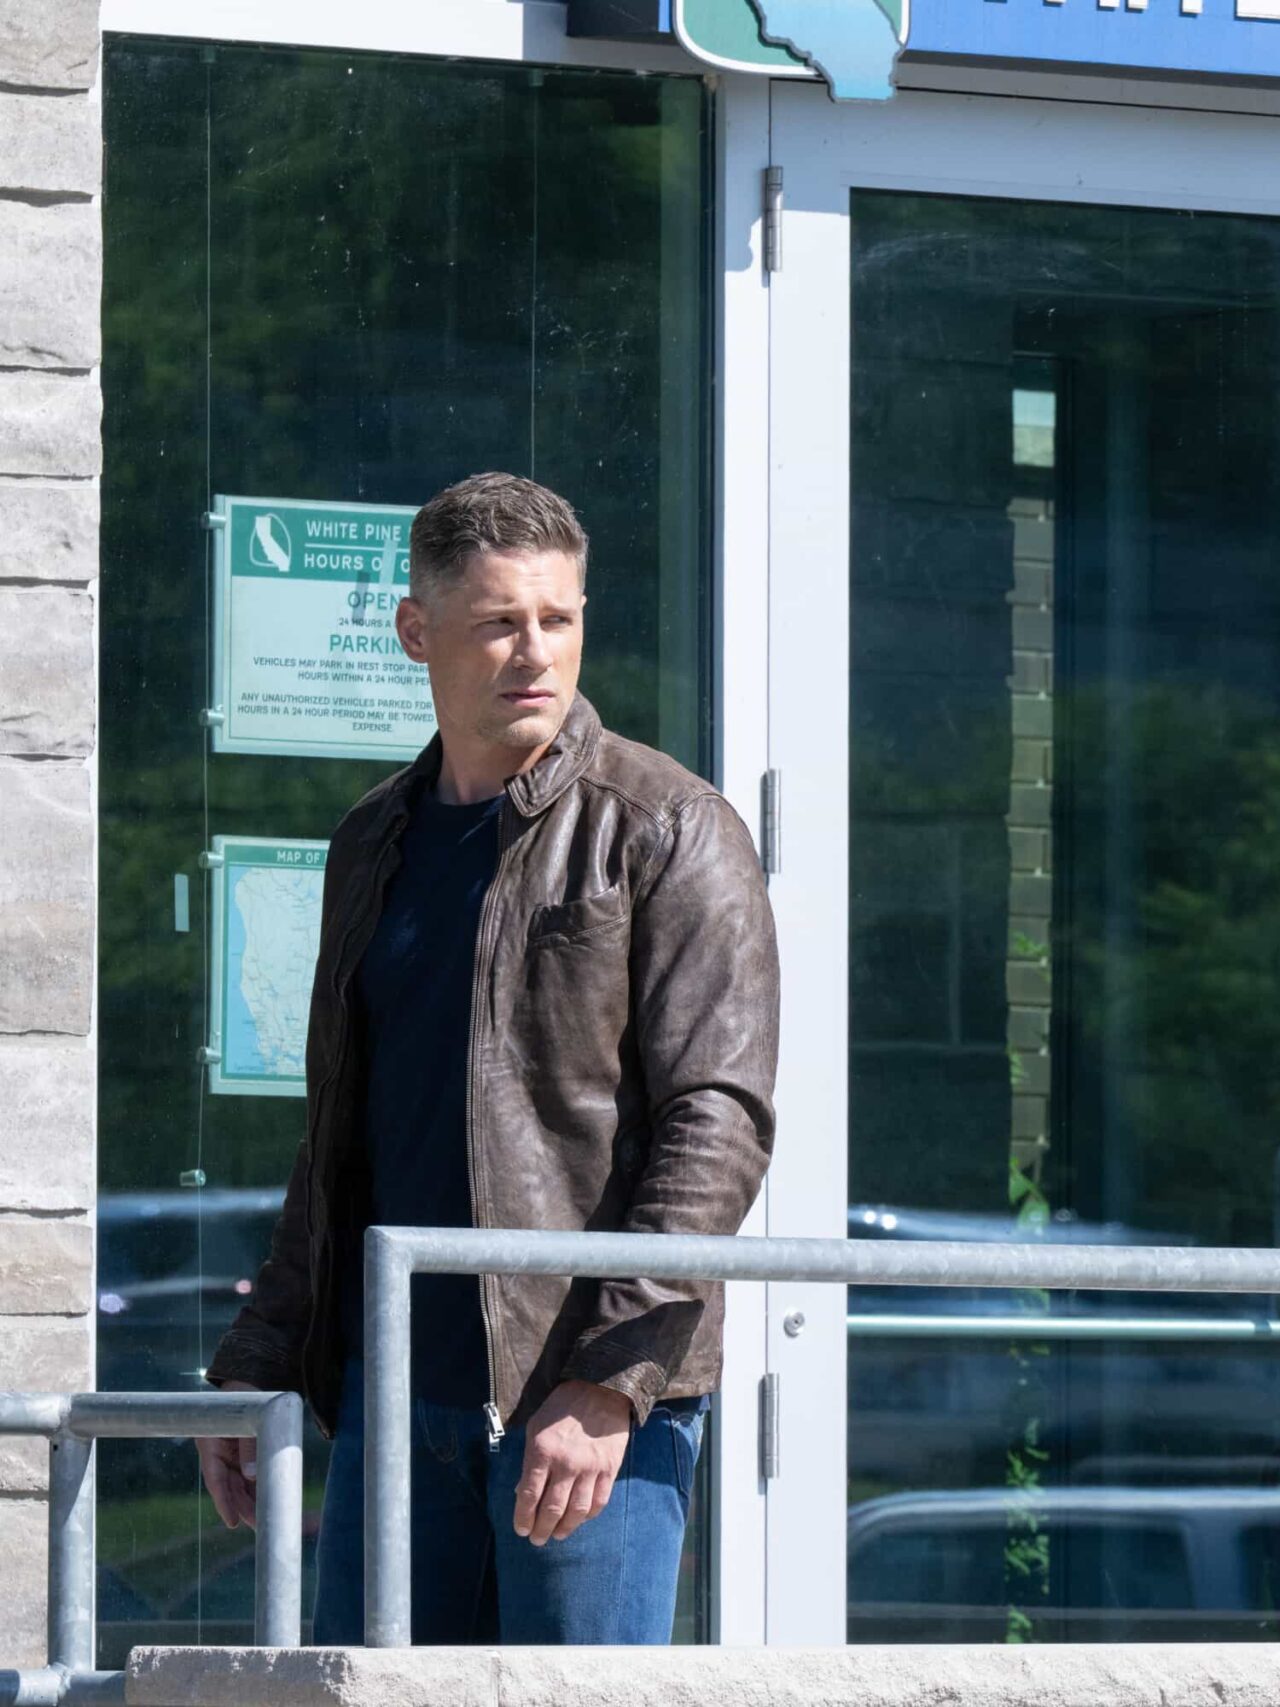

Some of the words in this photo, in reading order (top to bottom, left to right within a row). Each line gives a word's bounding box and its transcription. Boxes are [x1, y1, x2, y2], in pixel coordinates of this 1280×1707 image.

[306, 520, 358, 539] WHITE
[365, 523, 401, 541] PINE
[304, 553, 363, 571] HOURS
[347, 591, 401, 610] OPEN
[338, 617, 349, 626] 24
[352, 618, 383, 628] HOURS
[385, 620, 391, 628] A
[329, 634, 404, 655] PARKIN
[253, 656, 297, 667] VEHICLES
[299, 659, 316, 668] MAY
[320, 660, 342, 669] PARK
[346, 661, 354, 670] IN
[357, 662, 379, 671] REST
[382, 663, 405, 672] STOP
[408, 664, 429, 673] PAR
[298, 671, 329, 681] HOURS
[331, 673, 363, 682] WITHIN
[366, 674, 372, 682] A
[375, 674, 385, 683] 24
[388, 675, 412, 685] HOUR
[241, 692, 259, 701] ANY
[262, 693, 330, 705] UNAUTHORIZED
[333, 696, 375, 707] VEHICLES
[378, 699, 412, 709] PARKED
[415, 701, 432, 710] FOR
[238, 705, 268, 714] HOURS
[271, 706, 280, 714] IN
[283, 707, 289, 715] A
[292, 707, 302, 716] 24
[305, 708, 329, 718] HOUR
[332, 709, 365, 719] PERIOD
[367, 711, 385, 720] MAY
[388, 712, 400, 720] BE
[402, 713, 434, 722] TOWED
[277, 851, 301, 863] MAP
[305, 852, 321, 864] OF
